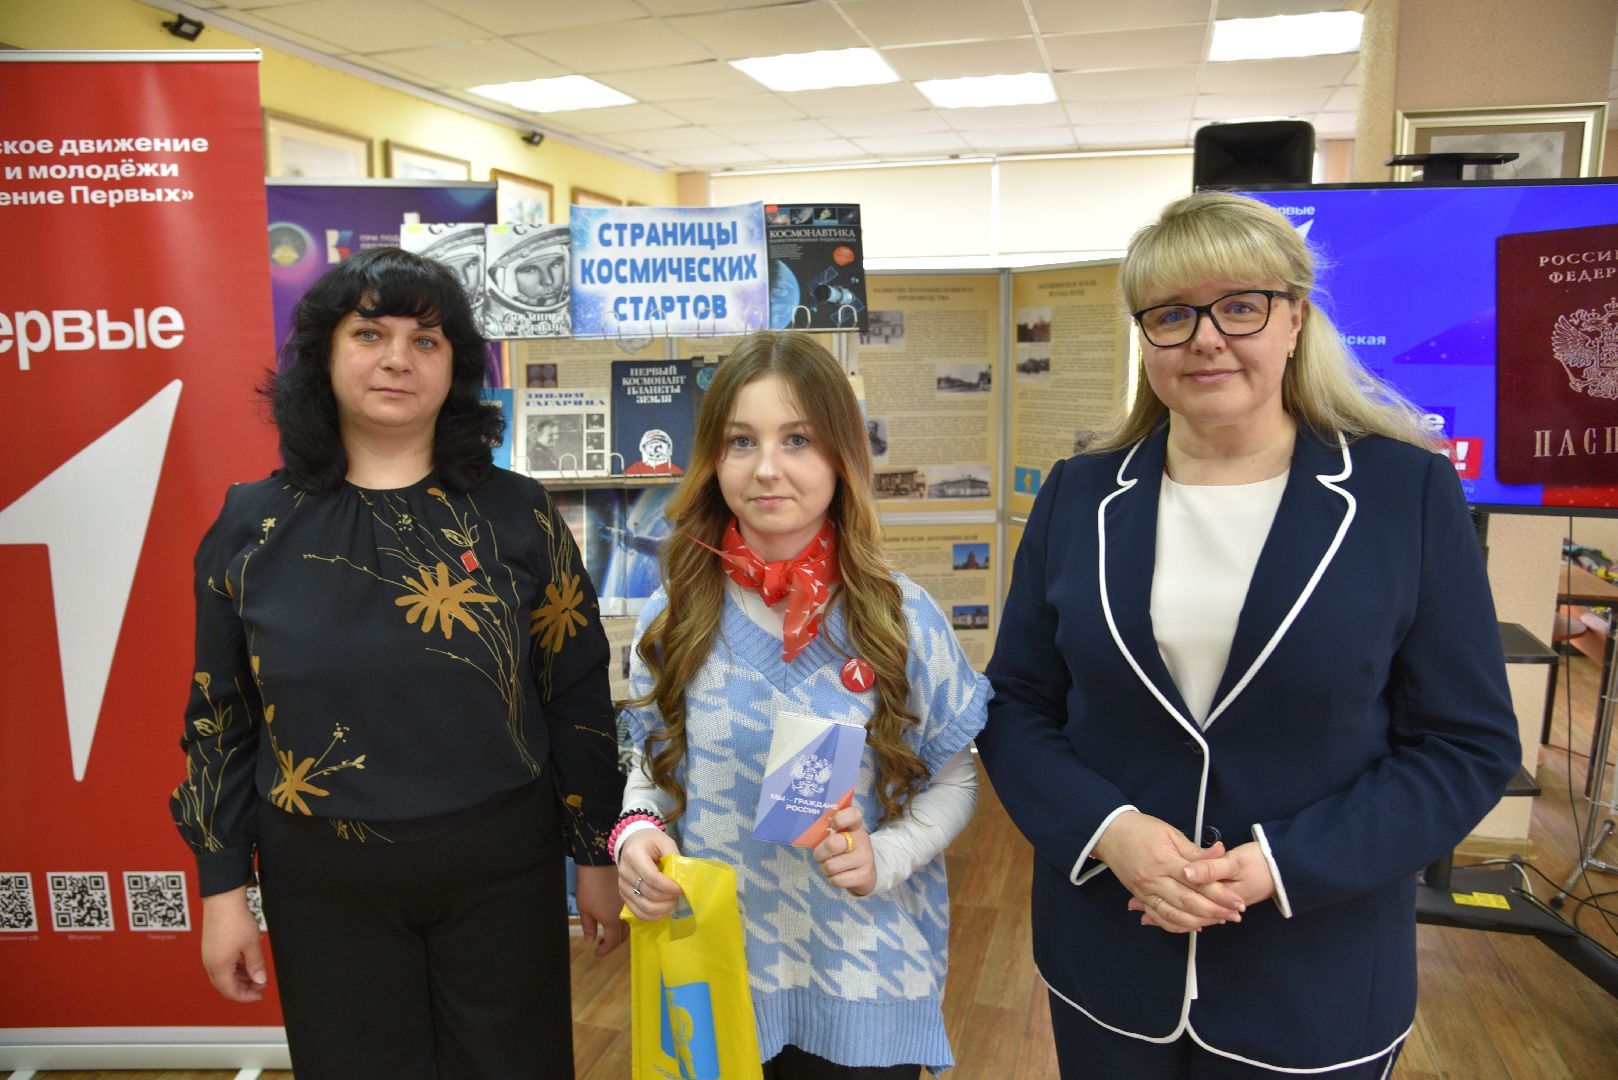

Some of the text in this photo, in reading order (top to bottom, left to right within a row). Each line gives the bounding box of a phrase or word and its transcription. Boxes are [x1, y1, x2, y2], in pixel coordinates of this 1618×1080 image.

[0, 137, 209, 156] кое движение
[5, 159, 180, 181] и молодёжи
[70, 186, 195, 208] Первых»
[598, 221, 738, 250] СТРАНИЦЫ
[769, 229, 857, 239] КОСМОНАВТИКА
[580, 254, 758, 285] КОСМИЧЕСКИХ
[613, 295, 727, 322] СТАРТОВ
[630, 365, 678, 377] ПЕРВЫЙ
[622, 375, 687, 386] КОСМОНАВТ
[627, 385, 681, 395] ПЛАНЕТЫ
[526, 399, 606, 407] ГАГАРИНА
[770, 793, 786, 802] МЫ
[793, 797, 840, 810] ГРАЖДАНЕ
[785, 804, 820, 815] РОССИИ
